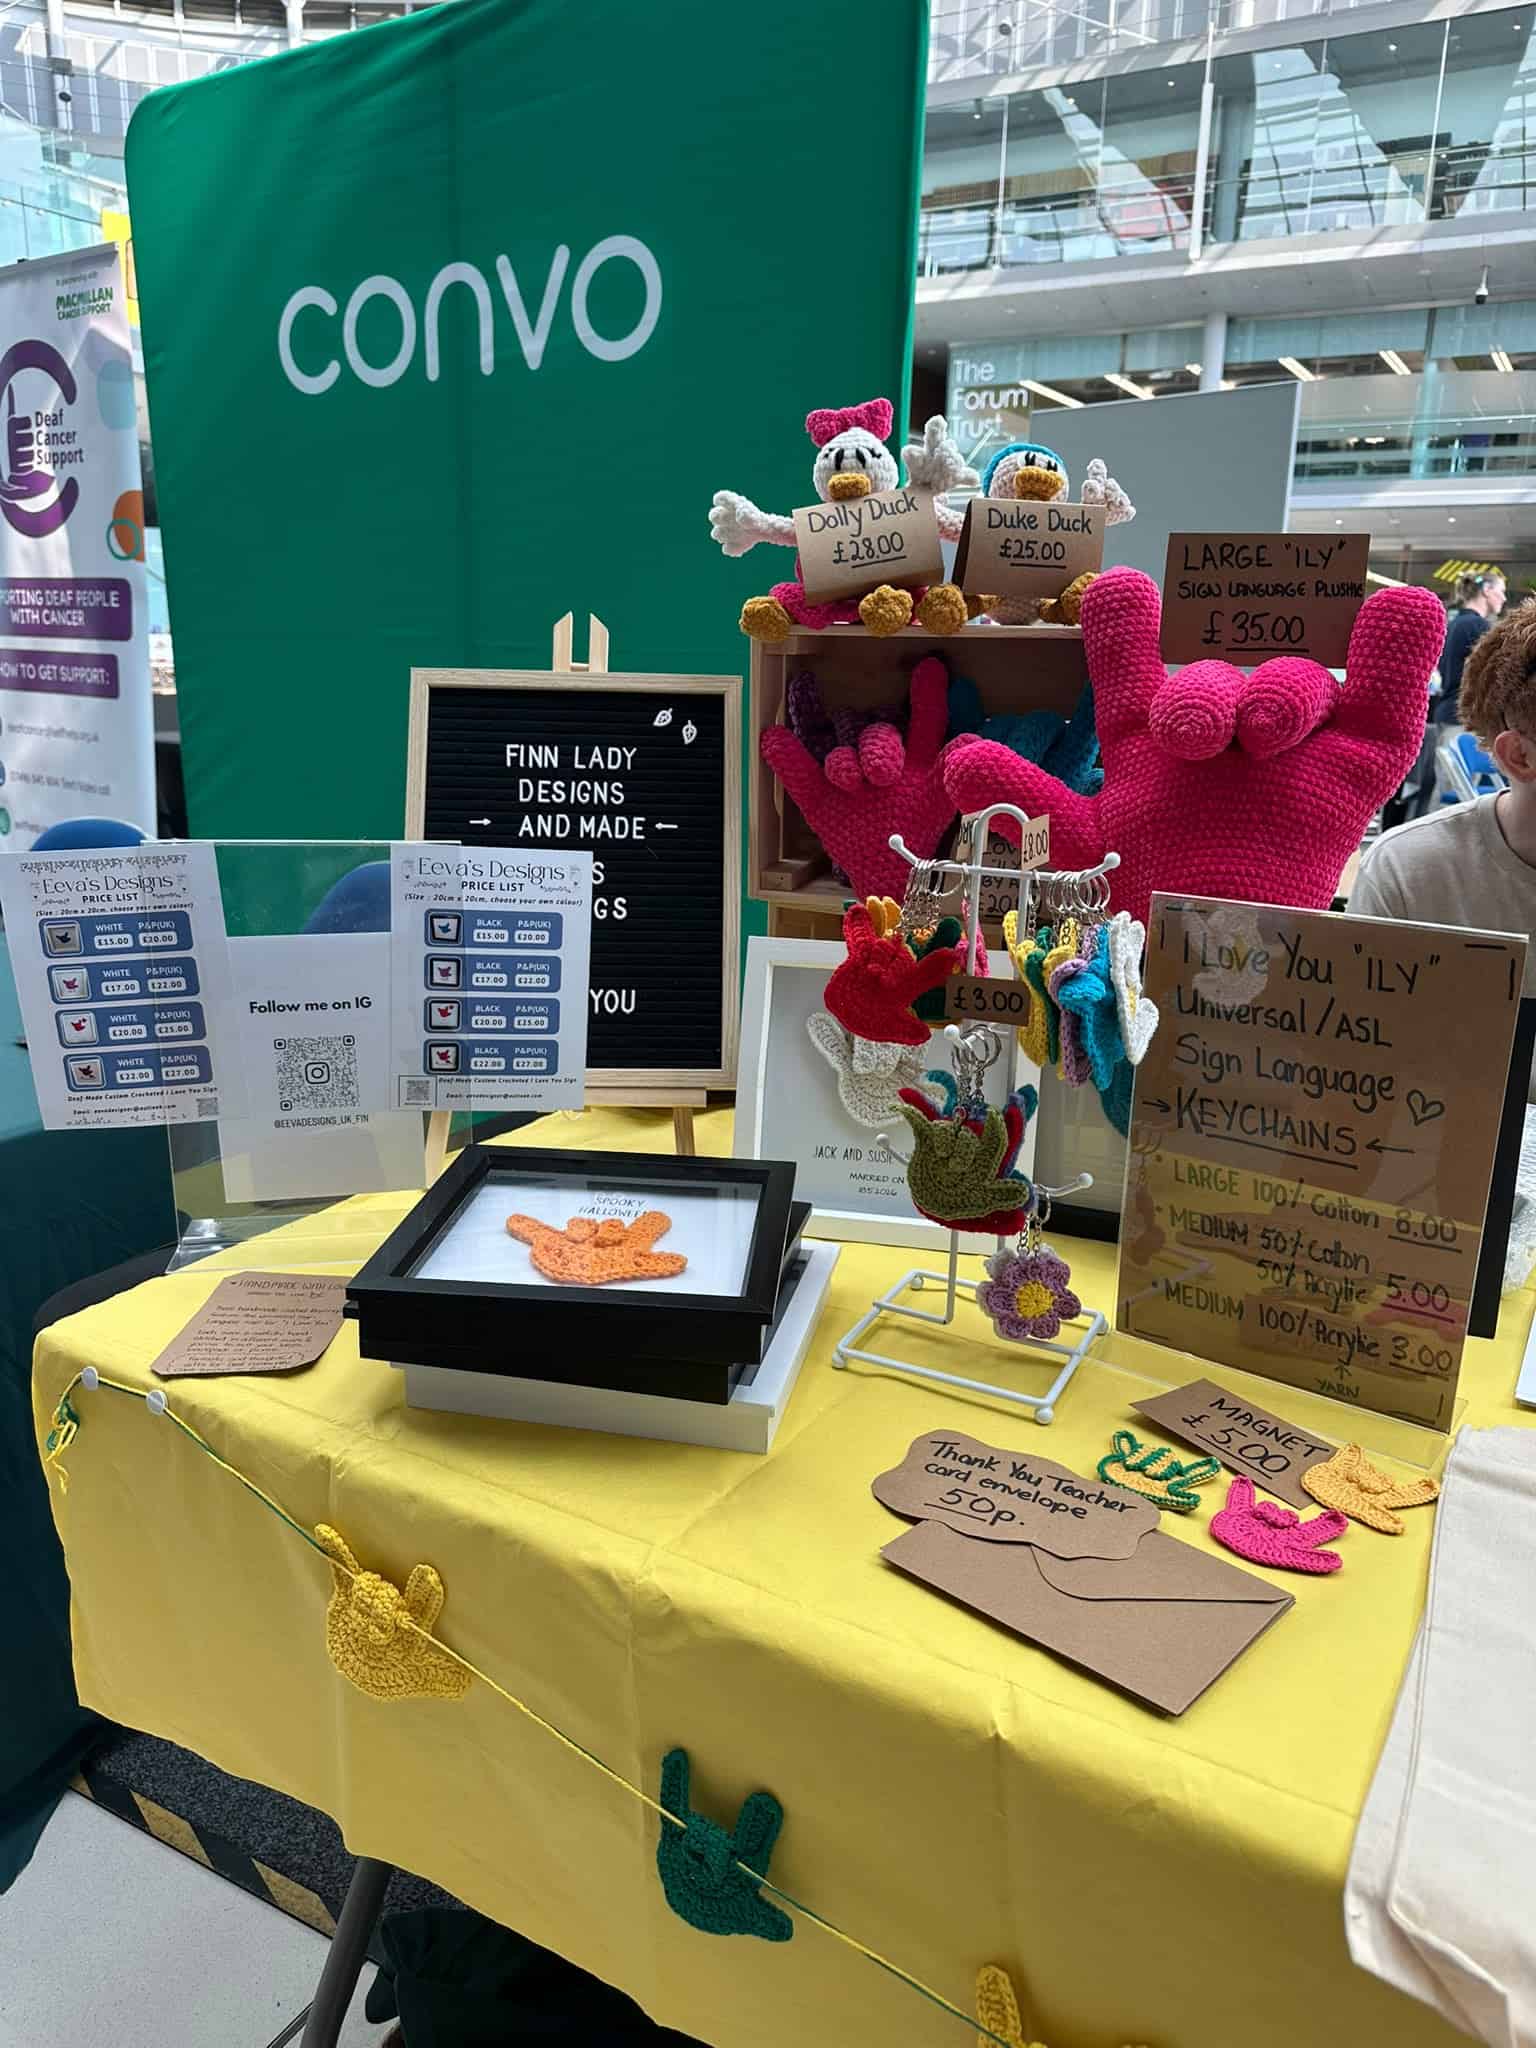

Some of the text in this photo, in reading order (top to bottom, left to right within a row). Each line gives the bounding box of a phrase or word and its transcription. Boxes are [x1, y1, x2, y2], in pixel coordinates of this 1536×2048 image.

[953, 360, 995, 383] The
[952, 387, 1029, 411] Forum
[35, 409, 64, 427] Deaf
[951, 414, 1003, 438] Trust
[35, 430, 77, 446] Cancer
[36, 448, 84, 469] Support
[807, 491, 919, 536] Dolly Duck
[987, 507, 1092, 535] Duke Duck
[833, 531, 905, 564] £28.00
[999, 537, 1066, 561] £25.00
[1183, 542, 1273, 571] LARGE
[45, 589, 73, 606] DEAF
[76, 590, 120, 608] PEOPLE
[1178, 580, 1222, 599] SIGN
[1228, 580, 1306, 599] LANGUAGE
[10, 608, 86, 627] WITH CANCER
[20, 663, 36, 679] TO
[38, 664, 58, 681] GET
[506, 744, 637, 771] FINN LADY
[519, 779, 625, 805] DESIGNS
[518, 815, 646, 840] AND MADE
[418, 857, 565, 885] Eeva's Designs
[42, 875, 174, 895] Eeva's Designs
[461, 881, 525, 892] PRICE LIST
[82, 892, 139, 904] PRICE LIST
[95, 922, 123, 932] WHITE
[476, 919, 503, 927] BLACK
[476, 962, 501, 970] BLACK
[1200, 935, 1270, 975] Love
[1277, 931, 1334, 984] You
[102, 968, 131, 978] WHITE
[249, 996, 373, 1014] Follow me on IG
[475, 1005, 500, 1013] BLACK
[953, 988, 1024, 1014] £3.00
[110, 1014, 138, 1023] WHITE
[117, 1057, 145, 1067] WHITE
[474, 1047, 500, 1055] BLACK
[1175, 1032, 1396, 1114] Sign Language
[1176, 1086, 1358, 1156] KEYCHAINS
[843, 1147, 863, 1161] AND
[1173, 1160, 1241, 1197] LARGE
[1310, 1192, 1380, 1230] Cotton
[1395, 1208, 1458, 1243] 8.00
[1168, 1204, 1248, 1245] MEDIUM
[1386, 1273, 1451, 1310] 5.00
[1163, 1278, 1245, 1321] MEDIUM
[1391, 1335, 1453, 1371] 3.00
[1209, 1397, 1330, 1459] MAGNET
[930, 1440, 1138, 1514] Thank You Teacher
[924, 1461, 1089, 1520] card envelope
